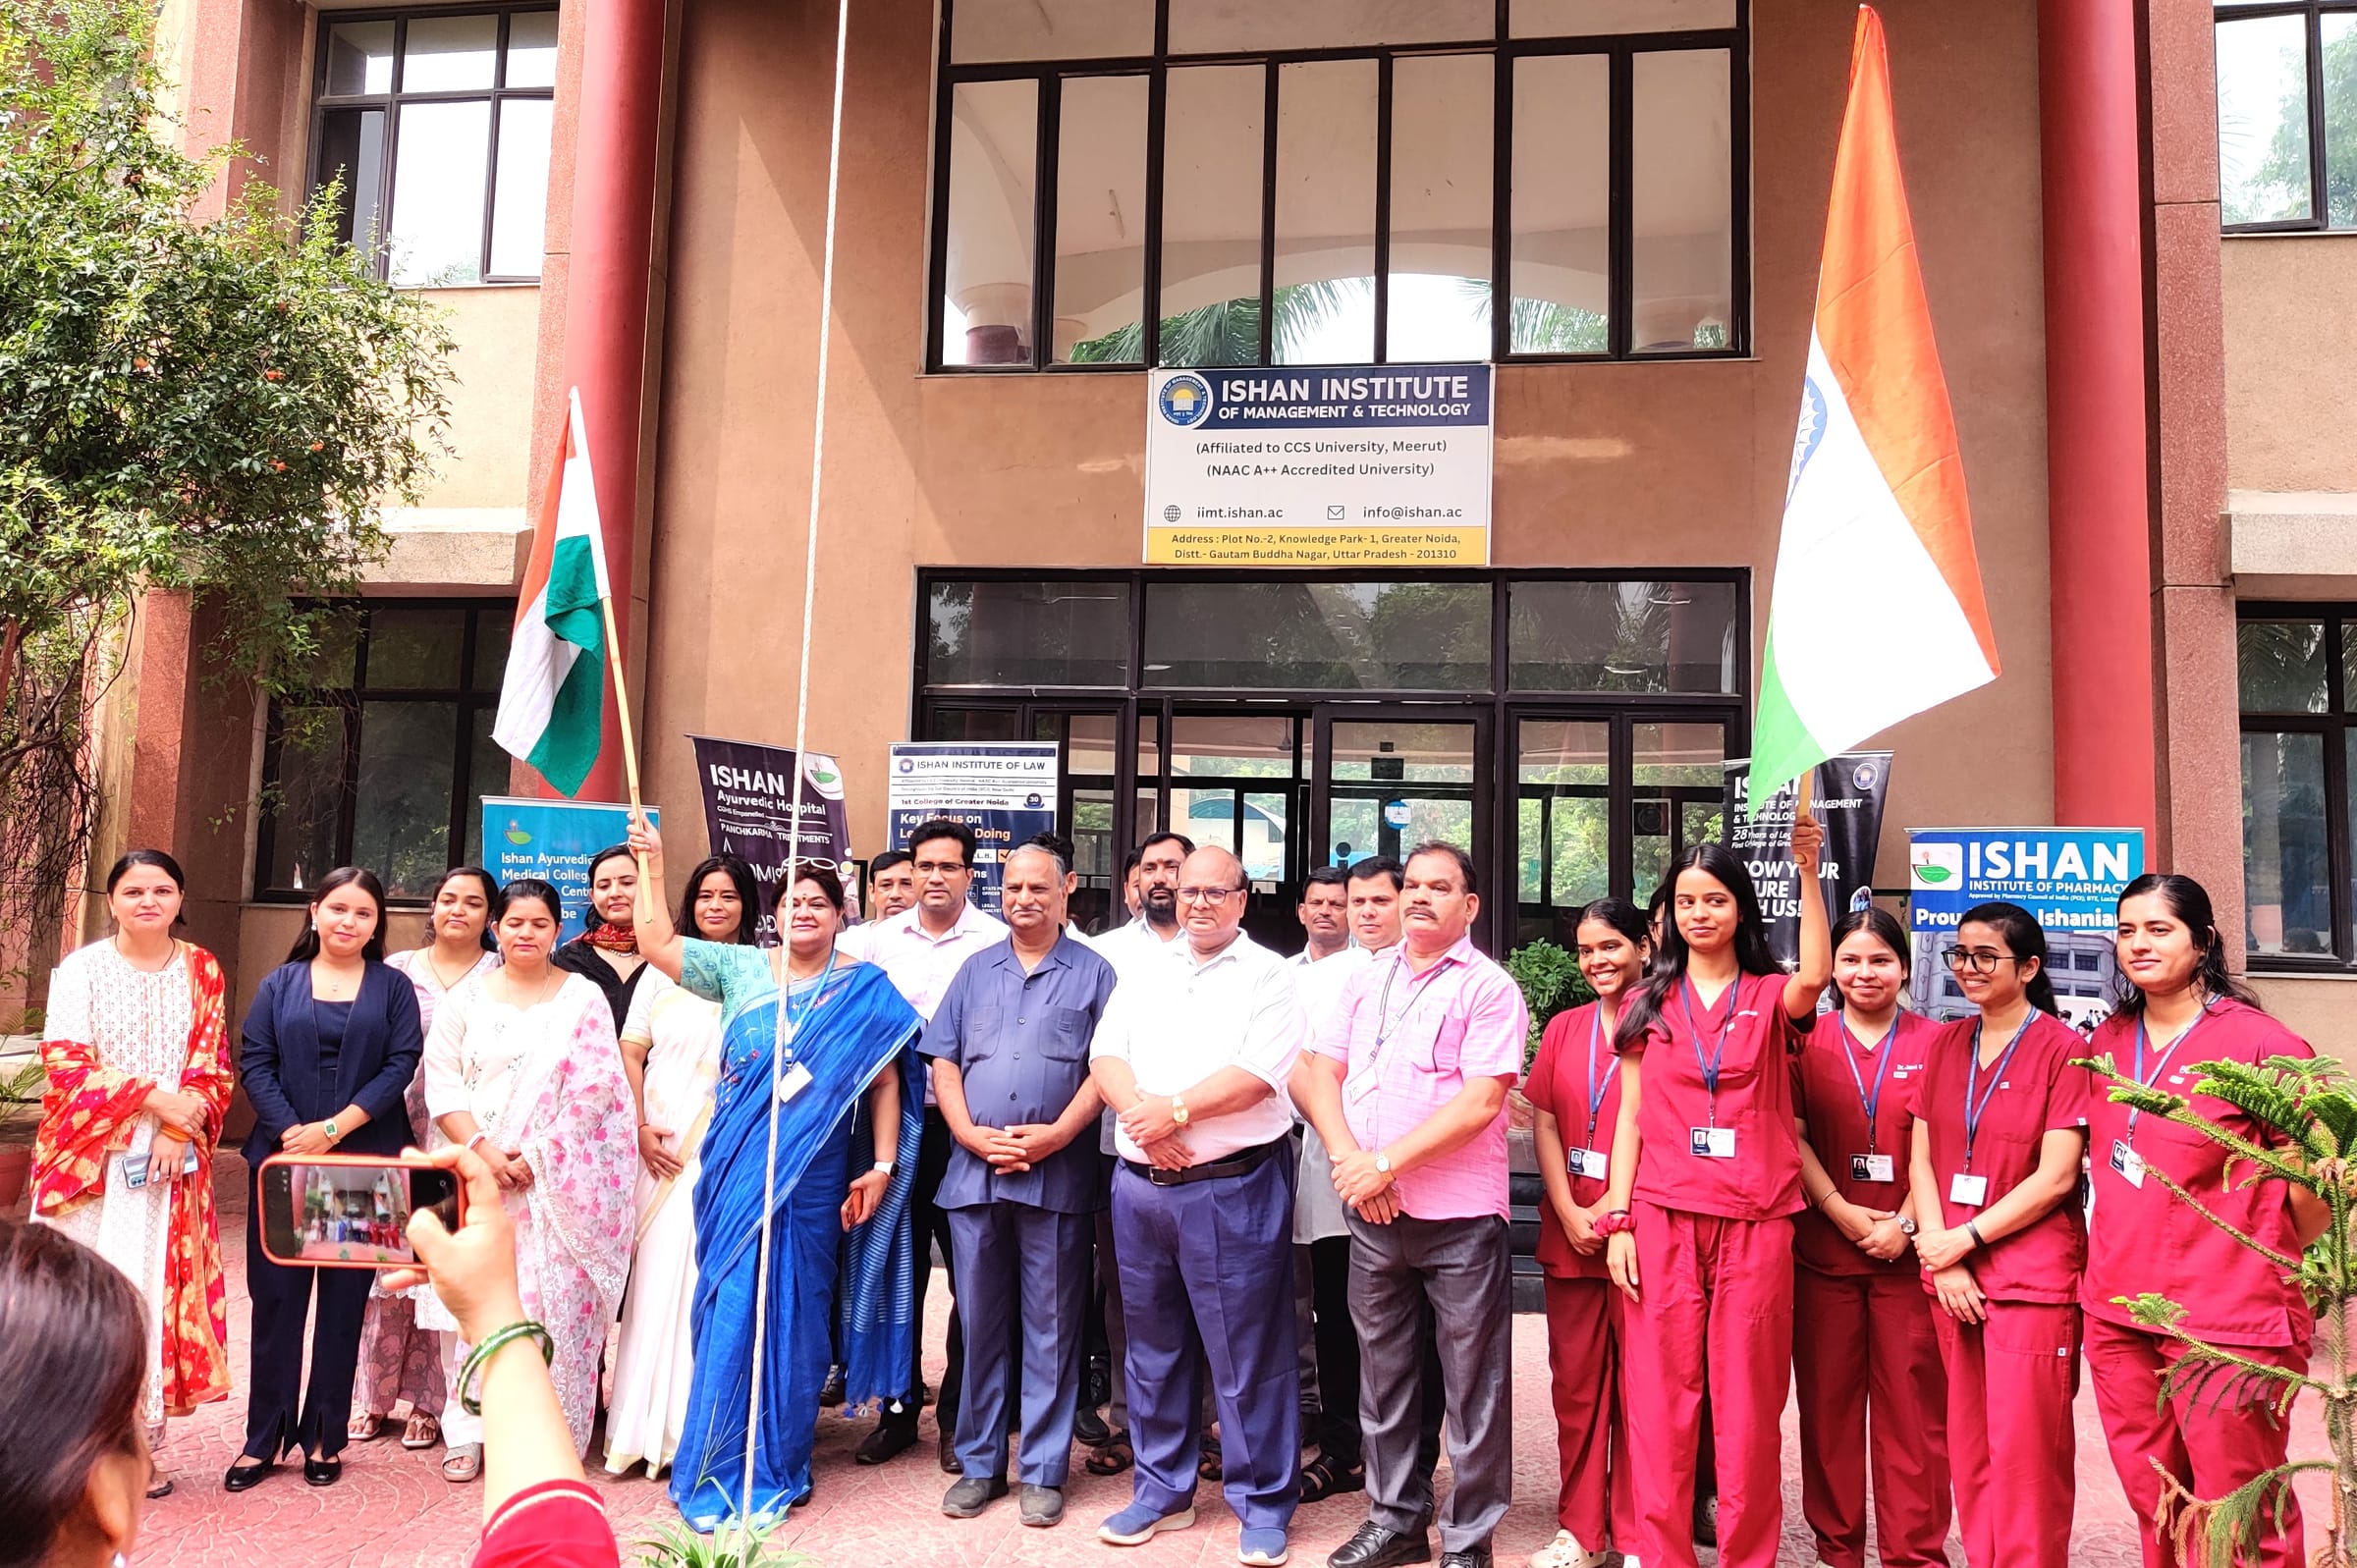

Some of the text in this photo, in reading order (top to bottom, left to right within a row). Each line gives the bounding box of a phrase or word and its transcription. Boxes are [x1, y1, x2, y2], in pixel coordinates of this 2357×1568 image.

[1222, 376, 1468, 403] ISHAN INSTITUTE
[1218, 407, 1239, 420] OF
[1243, 406, 1347, 419] MANAGEMENT
[1352, 406, 1363, 417] &
[1369, 403, 1471, 417] TECHNOLOGY
[1195, 439, 1447, 456] (Affiliated to CCS University, Meerut)
[1206, 462, 1435, 478] (NAAC A++ Accredited University)
[1196, 507, 1284, 518] iimt.ishan.ac
[1363, 506, 1462, 520] info@ishan.ac
[1172, 534, 1214, 544] Address
[1222, 534, 1242, 544] Plot
[1245, 534, 1277, 545] No.-2,
[1279, 534, 1337, 546] Knowledge
[1340, 534, 1367, 544] Park-
[1382, 534, 1422, 544] Greater
[1425, 534, 1461, 544] Noida,
[1210, 550, 1249, 560] Gautam
[1253, 549, 1293, 560] Buddha
[1296, 550, 1330, 561] Nagar,
[1333, 550, 1360, 560] Uttar
[1363, 549, 1407, 560] Pradesh
[1416, 550, 1456, 560] 201310
[952, 761, 1002, 770] INSTITUTE
[1023, 762, 1045, 771] LAW
[709, 764, 786, 796] ISHAN
[717, 789, 826, 816] Ayurvedic Hopital
[1780, 800, 1791, 809] OF
[1795, 799, 1862, 810] NAGEMENT
[900, 813, 924, 826] Key
[966, 815, 982, 824] on
[1742, 811, 1795, 823] THNOLOG
[720, 823, 830, 844] PANCHKARMA TRETMENTS
[974, 828, 1011, 840] Doing
[1732, 829, 1748, 840] 28
[501, 852, 533, 864] Ishan
[1968, 840, 2129, 882] ISHAN
[502, 868, 589, 884] Medical Colleg
[1743, 860, 1840, 880] OW YUR
[1969, 881, 2033, 892] INSTITUTE
[2037, 882, 2055, 892] OF
[1772, 899, 1803, 917] US!
[1915, 907, 2117, 927] Prou Ishania
